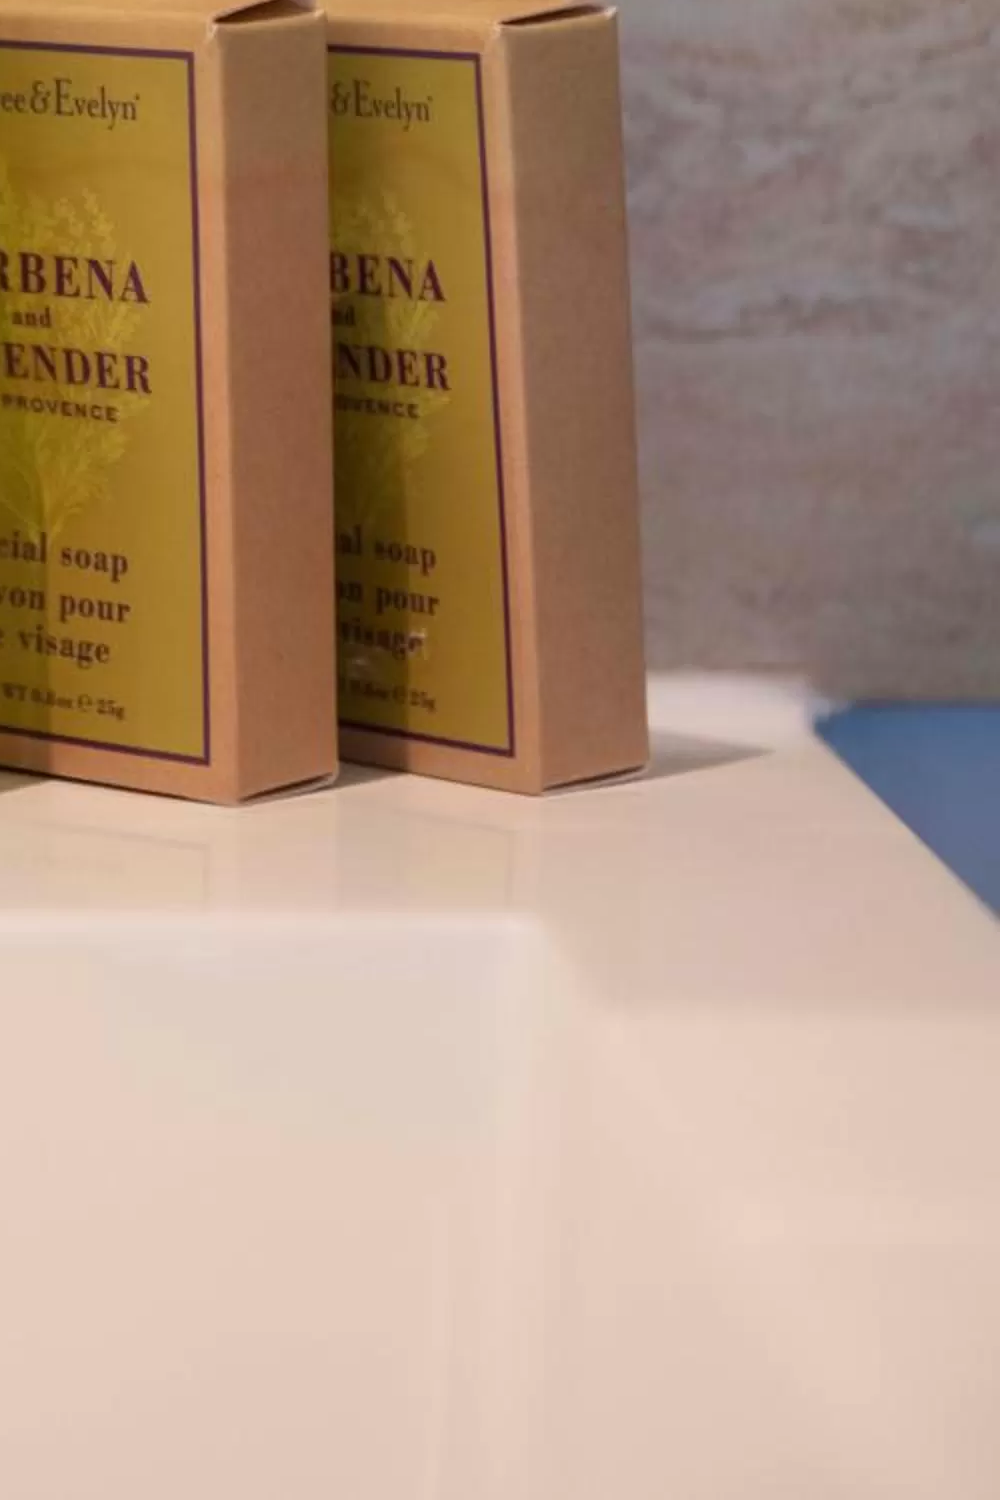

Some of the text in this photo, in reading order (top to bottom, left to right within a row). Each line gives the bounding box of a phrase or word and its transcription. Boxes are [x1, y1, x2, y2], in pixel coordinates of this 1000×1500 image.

[54, 78, 138, 130] Evelyn
[354, 80, 431, 130] Evelyn
[331, 251, 445, 303] BENA
[11, 306, 52, 329] and
[335, 342, 451, 392] NDER
[0, 393, 120, 424] PROVENCE
[60, 543, 129, 583] soap
[374, 541, 436, 575] soap
[59, 590, 131, 624] pour
[375, 585, 440, 617] pour
[18, 624, 111, 669] visage
